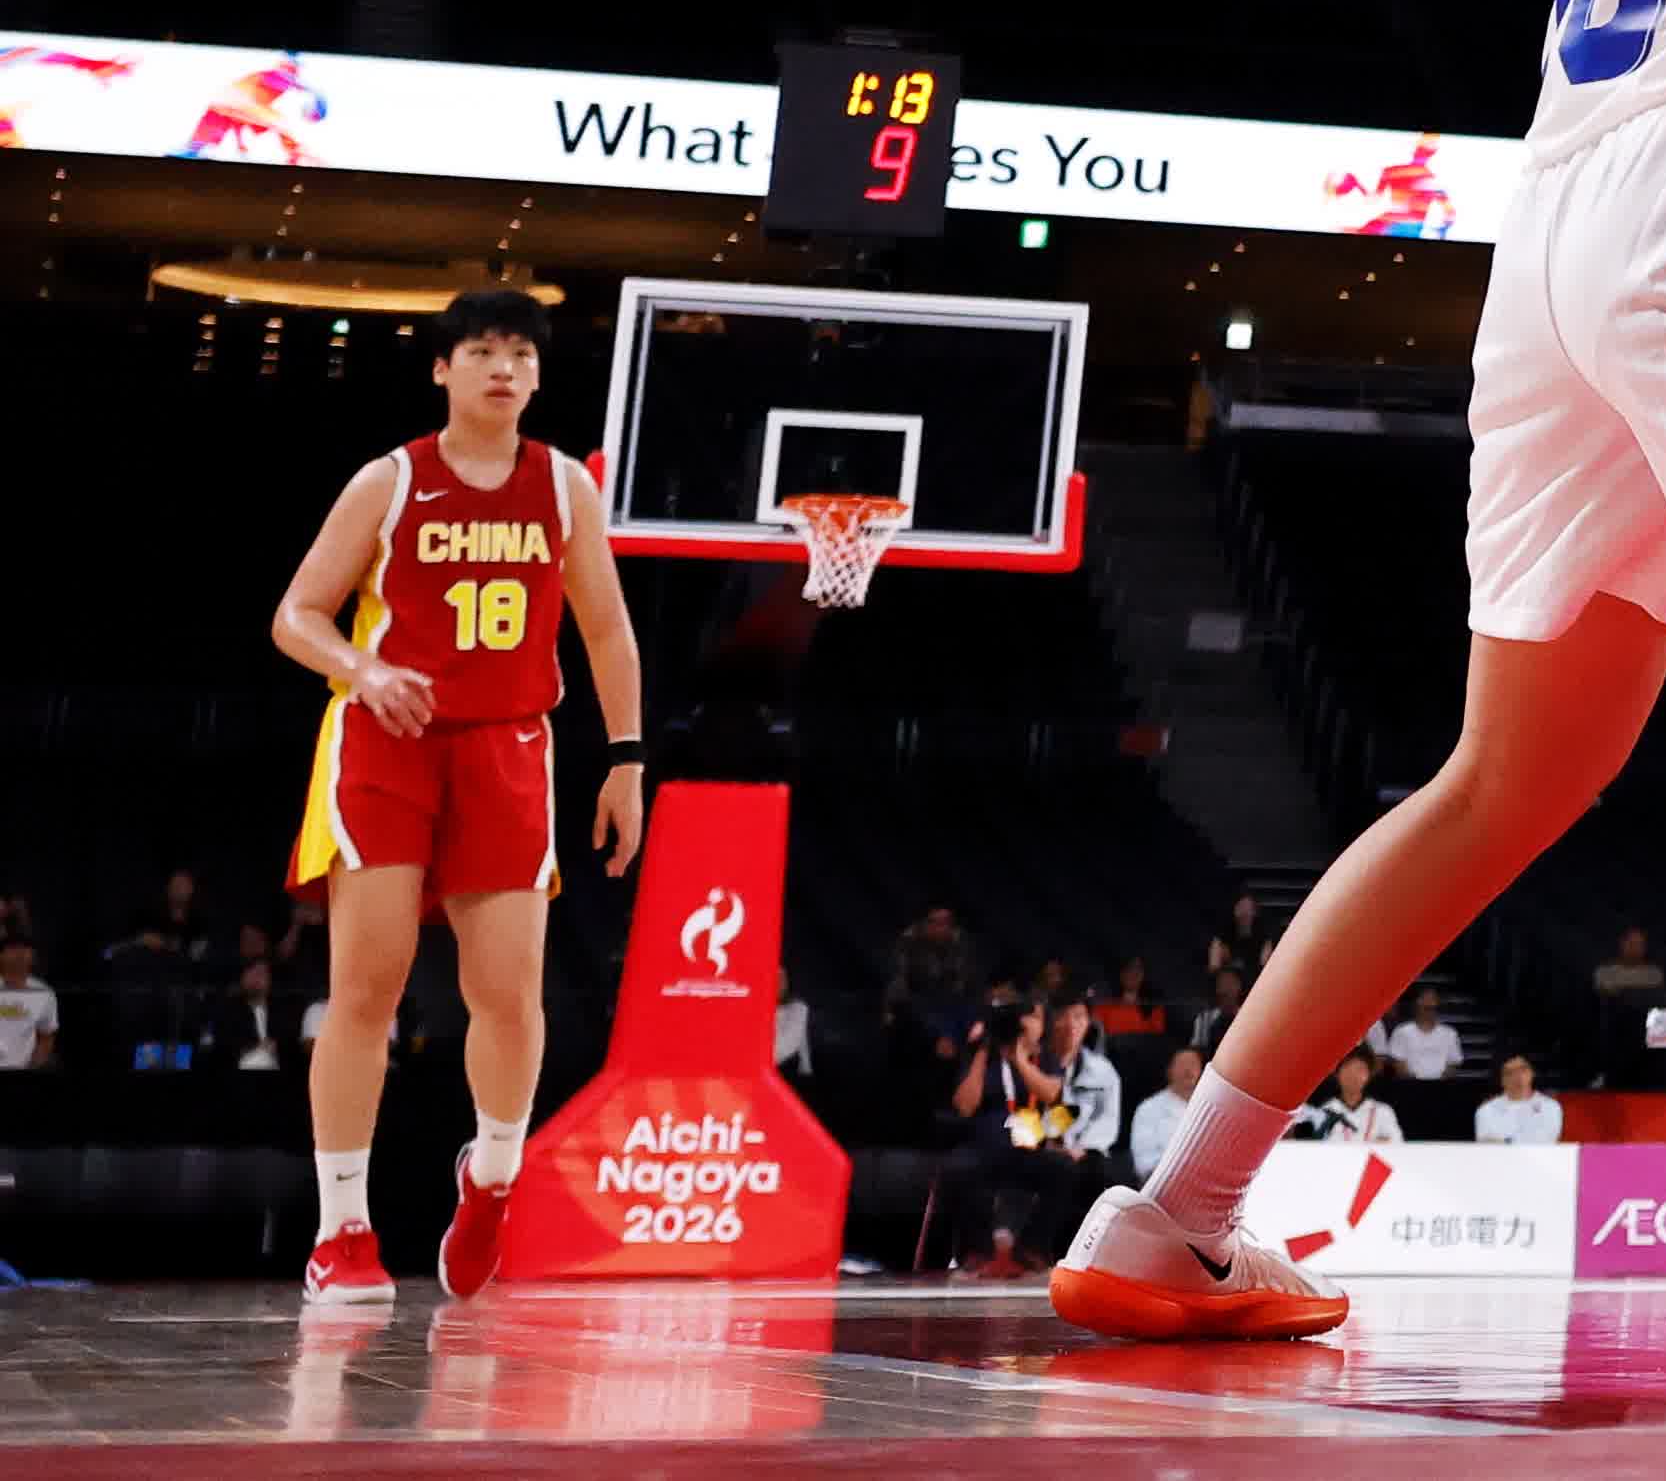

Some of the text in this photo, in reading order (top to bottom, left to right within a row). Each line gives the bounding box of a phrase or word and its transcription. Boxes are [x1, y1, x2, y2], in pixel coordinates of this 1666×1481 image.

[554, 99, 756, 168] What
[864, 126, 917, 203] 9
[1043, 134, 1171, 195] You
[416, 521, 551, 566] CHINA
[443, 579, 529, 652] 18
[623, 1112, 766, 1153] Aichi-
[595, 1156, 782, 1205] Nagoya
[623, 1204, 745, 1244] 2026
